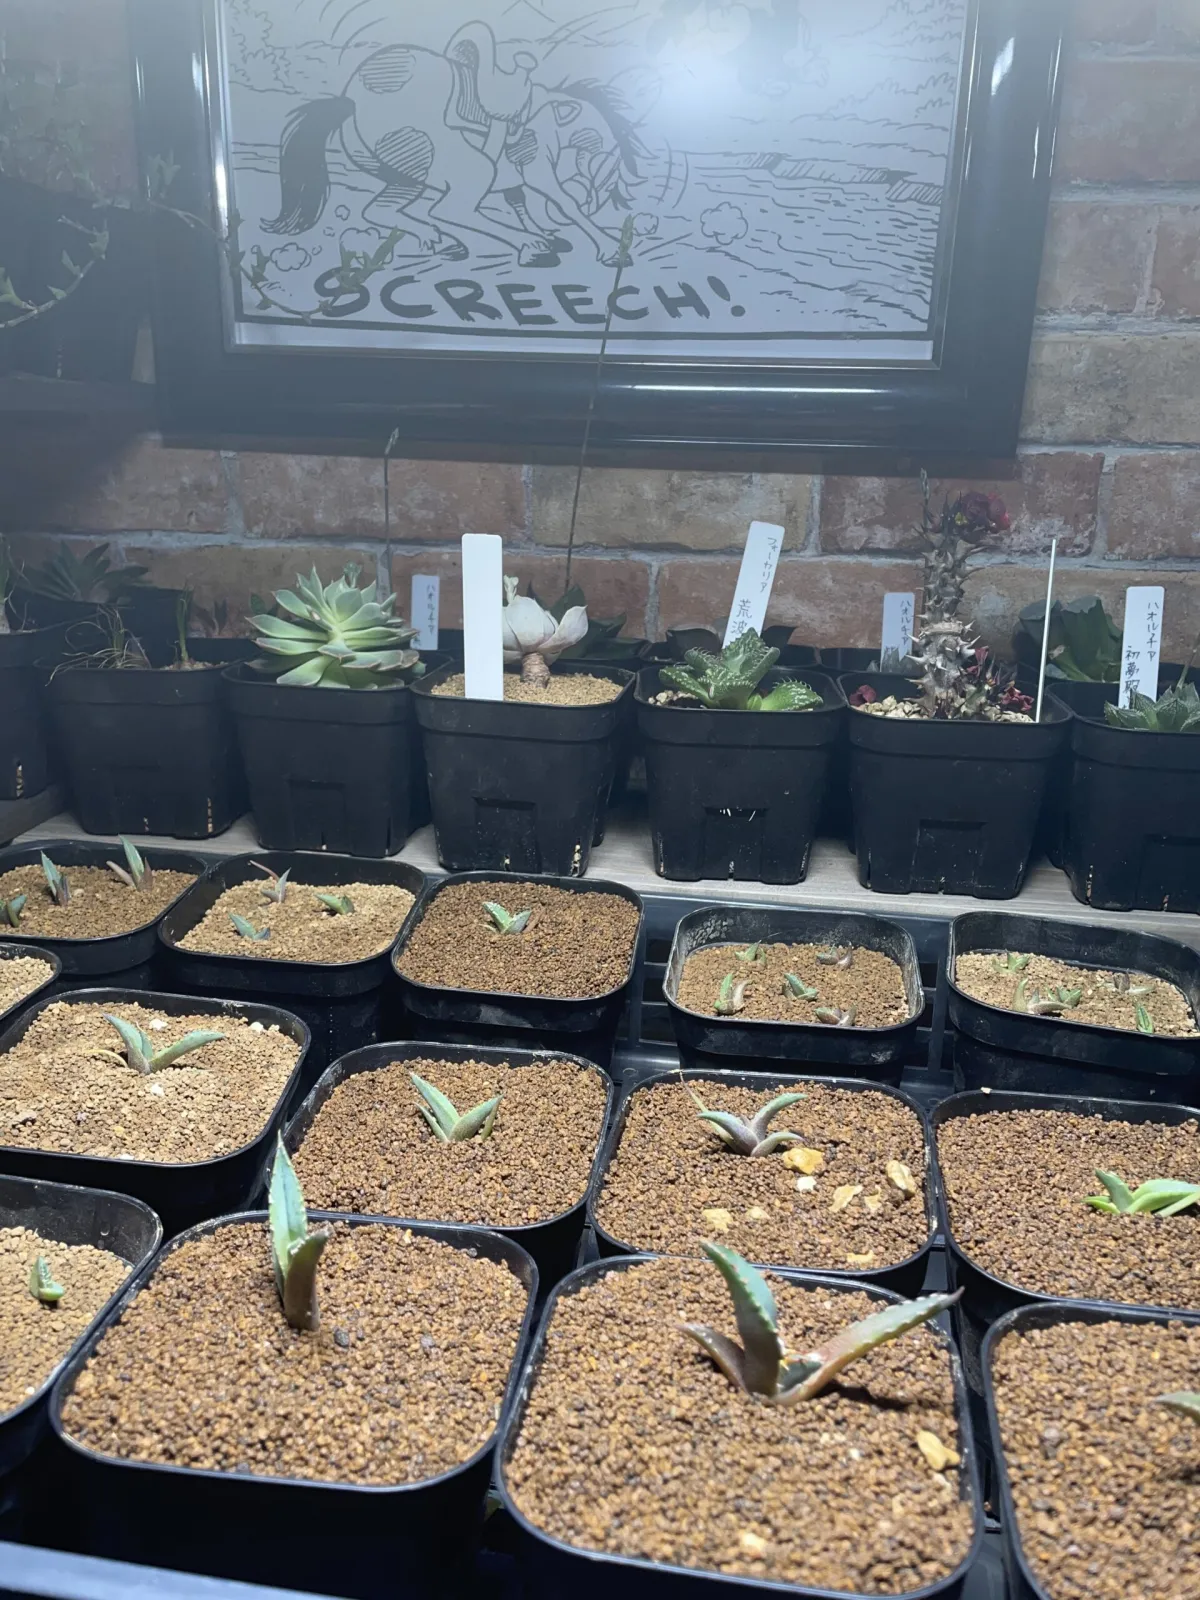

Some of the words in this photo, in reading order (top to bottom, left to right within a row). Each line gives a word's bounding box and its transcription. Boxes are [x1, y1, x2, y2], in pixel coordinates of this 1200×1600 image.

[313, 267, 746, 326] SCREECH!
[760, 537, 779, 593] フォーカリア
[731, 598, 752, 635] 荒波
[900, 600, 912, 645] ハオルチア
[1146, 602, 1160, 662] ハオルチア
